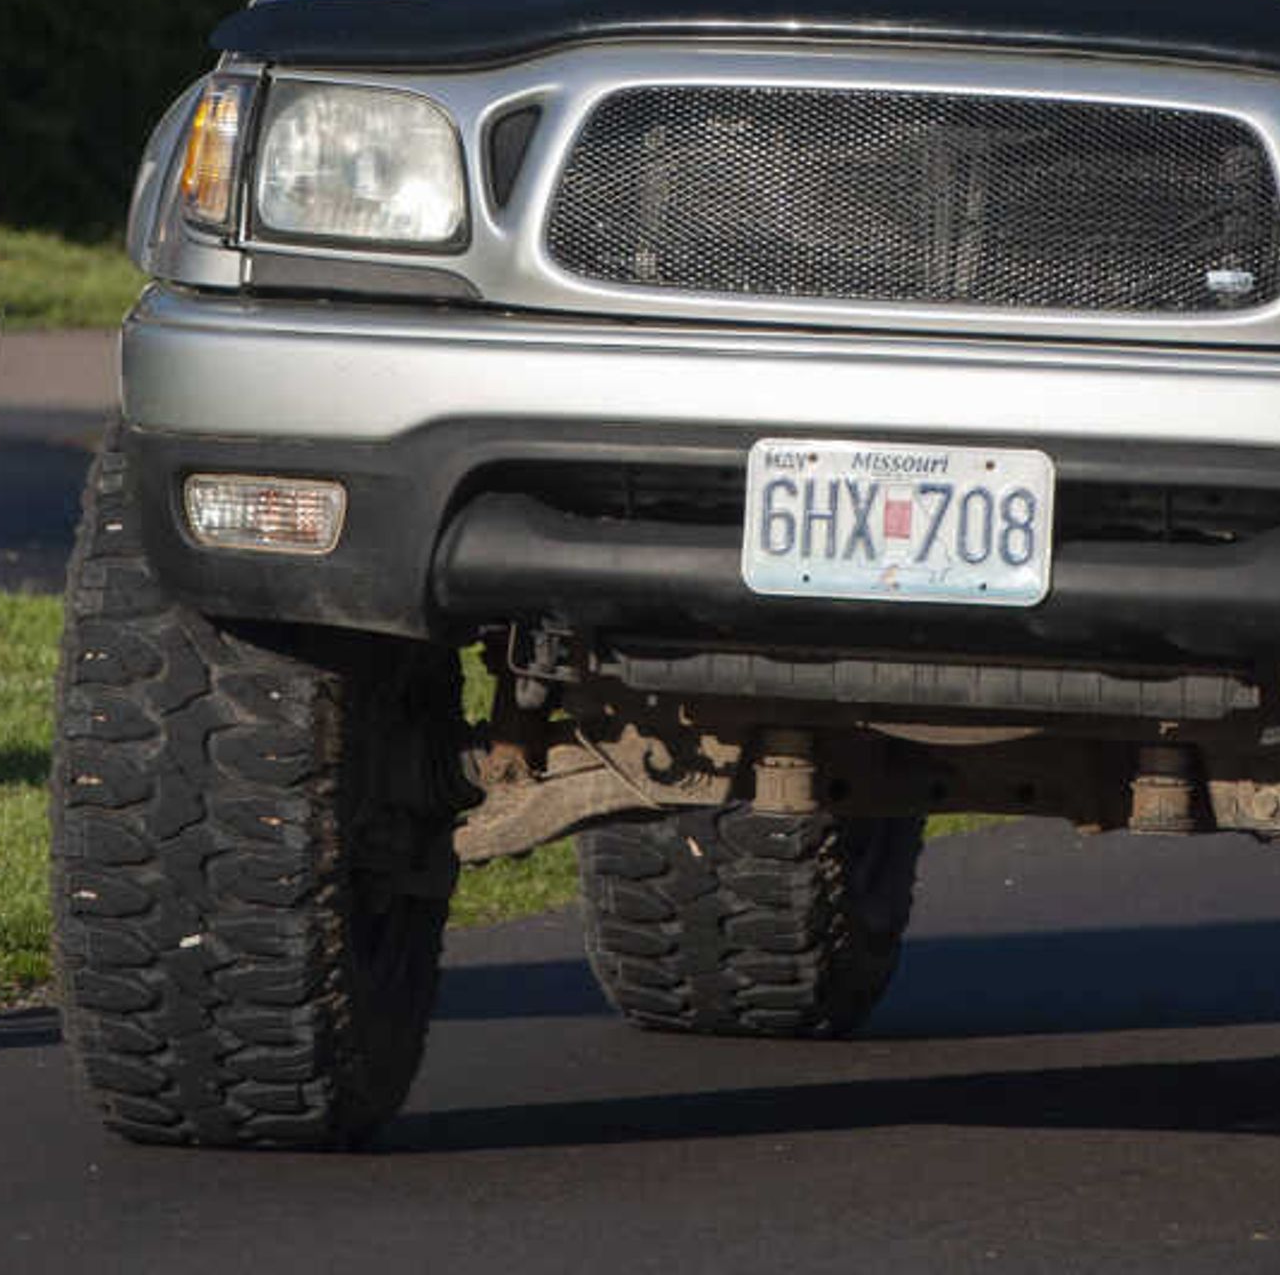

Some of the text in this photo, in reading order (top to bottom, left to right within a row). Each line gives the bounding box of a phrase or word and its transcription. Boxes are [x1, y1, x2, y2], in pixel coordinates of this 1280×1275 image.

[851, 451, 949, 475] Missouri
[760, 478, 1037, 567] 6HX 708
